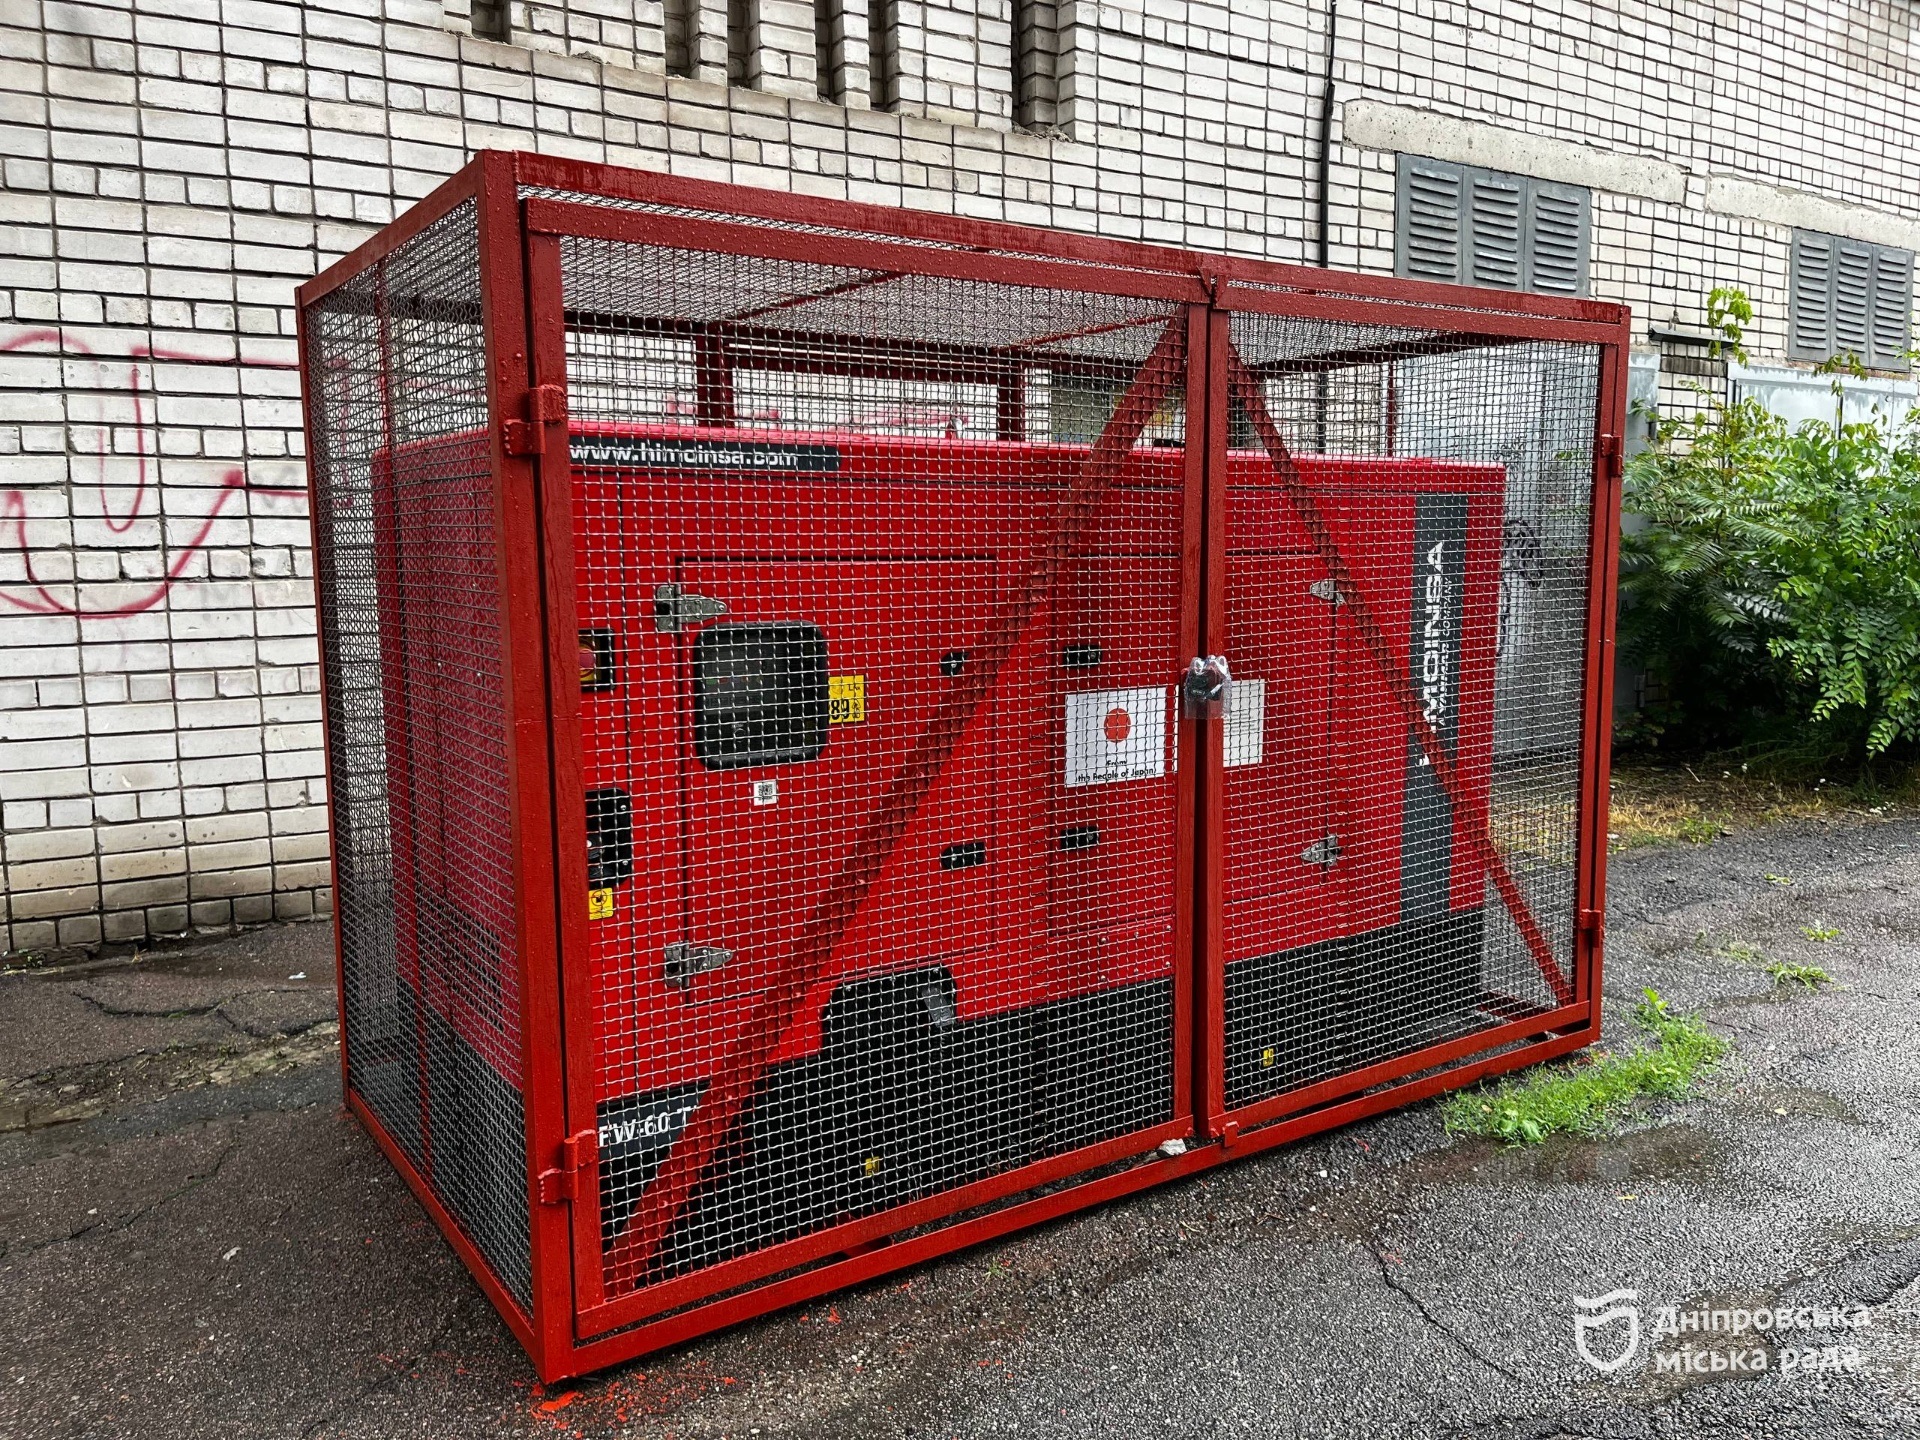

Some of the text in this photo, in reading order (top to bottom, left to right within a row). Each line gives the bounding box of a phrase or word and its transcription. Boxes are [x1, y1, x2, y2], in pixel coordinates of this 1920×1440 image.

[569, 443, 799, 466] www.himoinsa.com
[1442, 577, 1453, 637] COMPANY
[831, 699, 849, 720] 89
[1120, 767, 1129, 778] of
[1131, 768, 1154, 778] Japan
